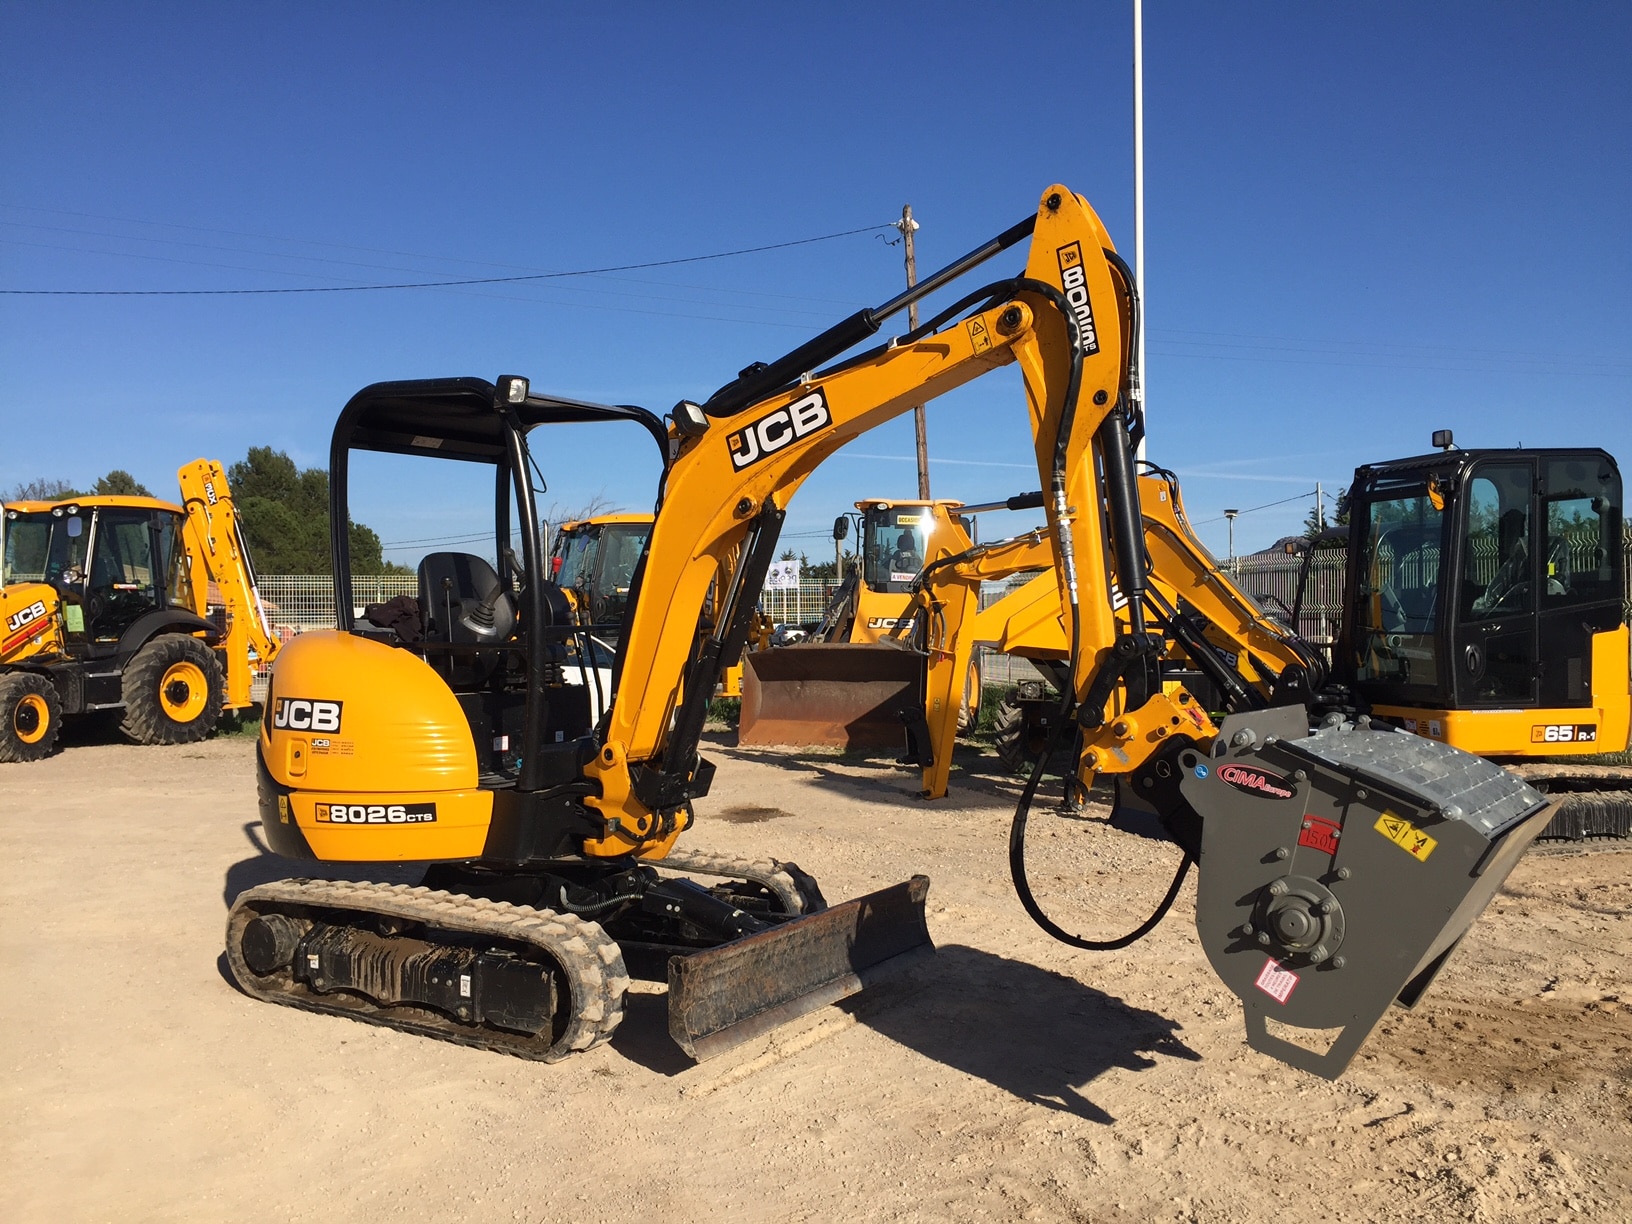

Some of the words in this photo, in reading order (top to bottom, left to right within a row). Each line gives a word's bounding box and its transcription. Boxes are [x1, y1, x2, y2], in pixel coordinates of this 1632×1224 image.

[733, 393, 828, 467] JCB
[205, 483, 217, 504] 3CX
[9, 601, 47, 630] JCB
[868, 618, 915, 628] JCB
[275, 700, 340, 731] JCB
[311, 739, 330, 747] JCB
[1545, 725, 1573, 741] 65
[1578, 731, 1596, 741] R-1
[1223, 767, 1266, 790] CIMA
[1264, 784, 1292, 798] Europe
